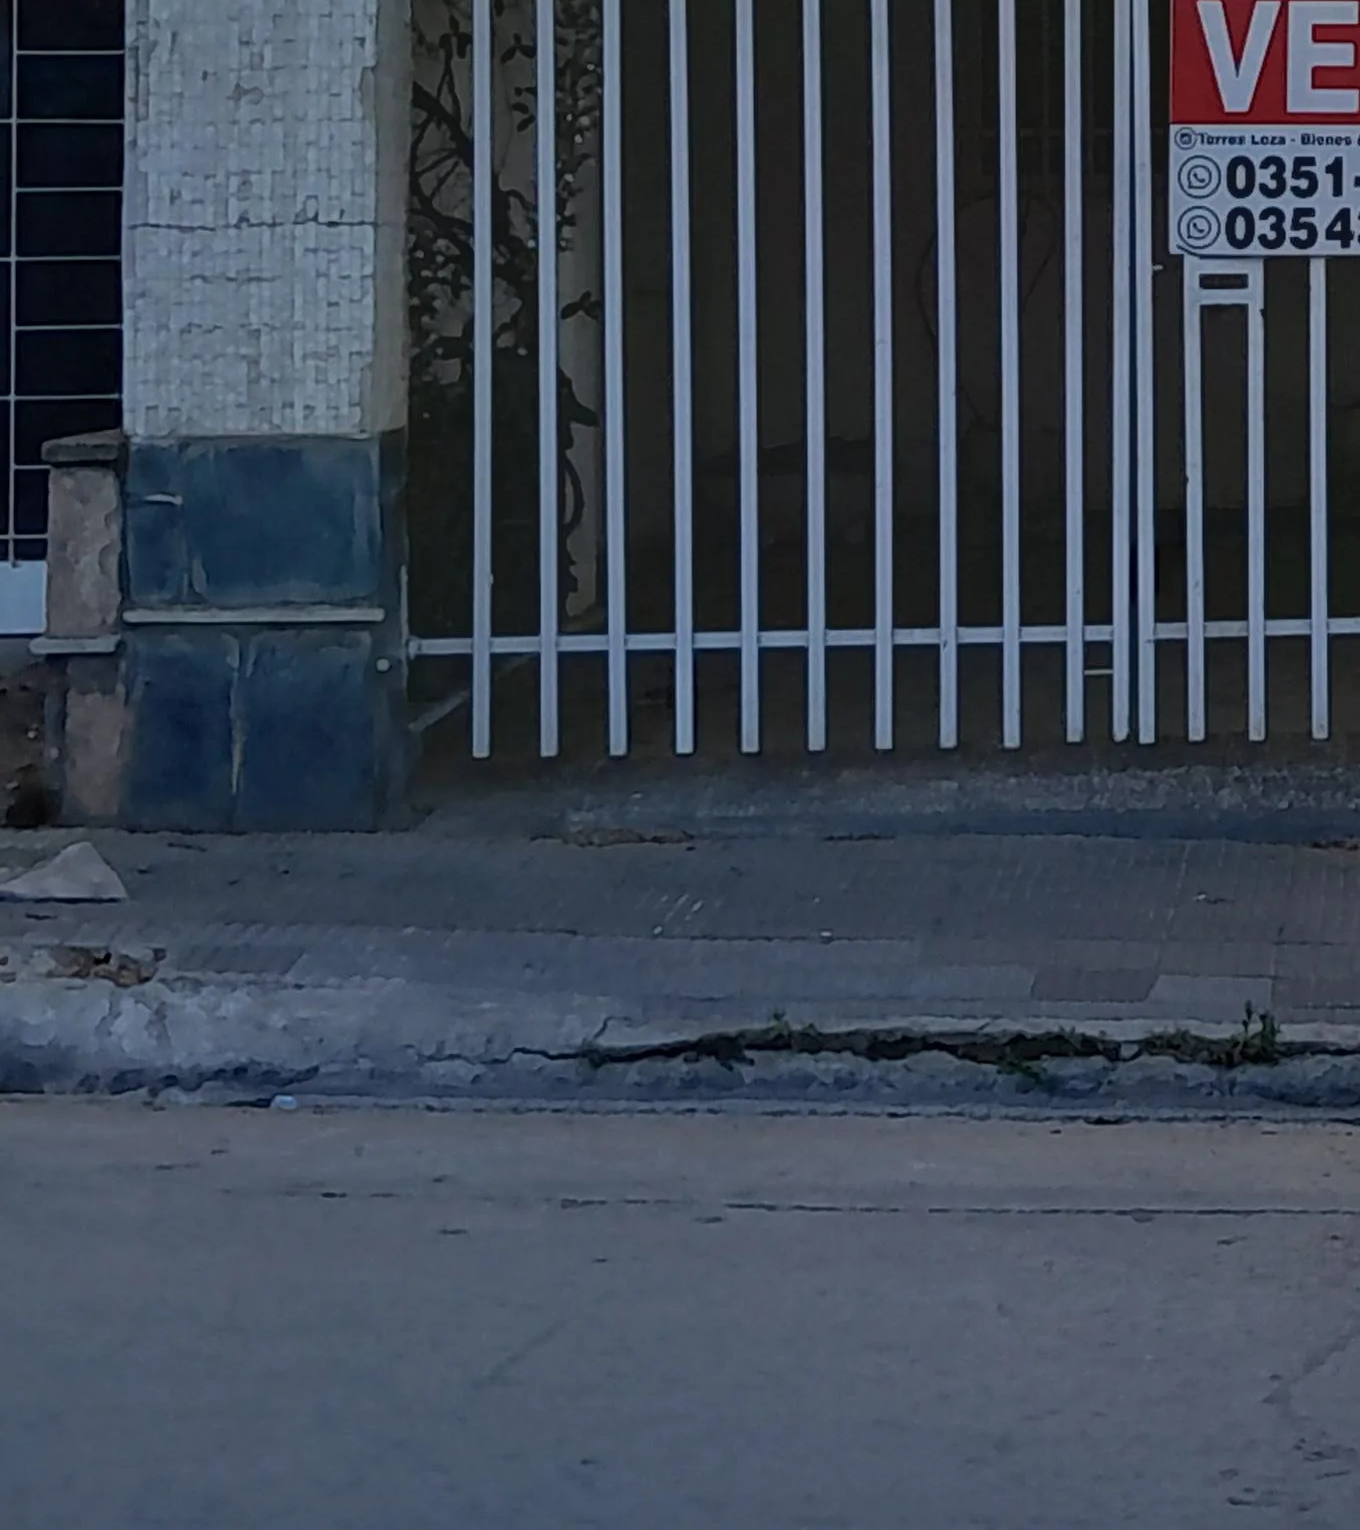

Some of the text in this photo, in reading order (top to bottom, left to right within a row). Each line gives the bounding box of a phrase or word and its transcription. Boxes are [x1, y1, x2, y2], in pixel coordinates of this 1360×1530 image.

[1199, 133, 1246, 146] Torres
[1251, 134, 1287, 146] Loza
[1300, 133, 1352, 146] Bienes
